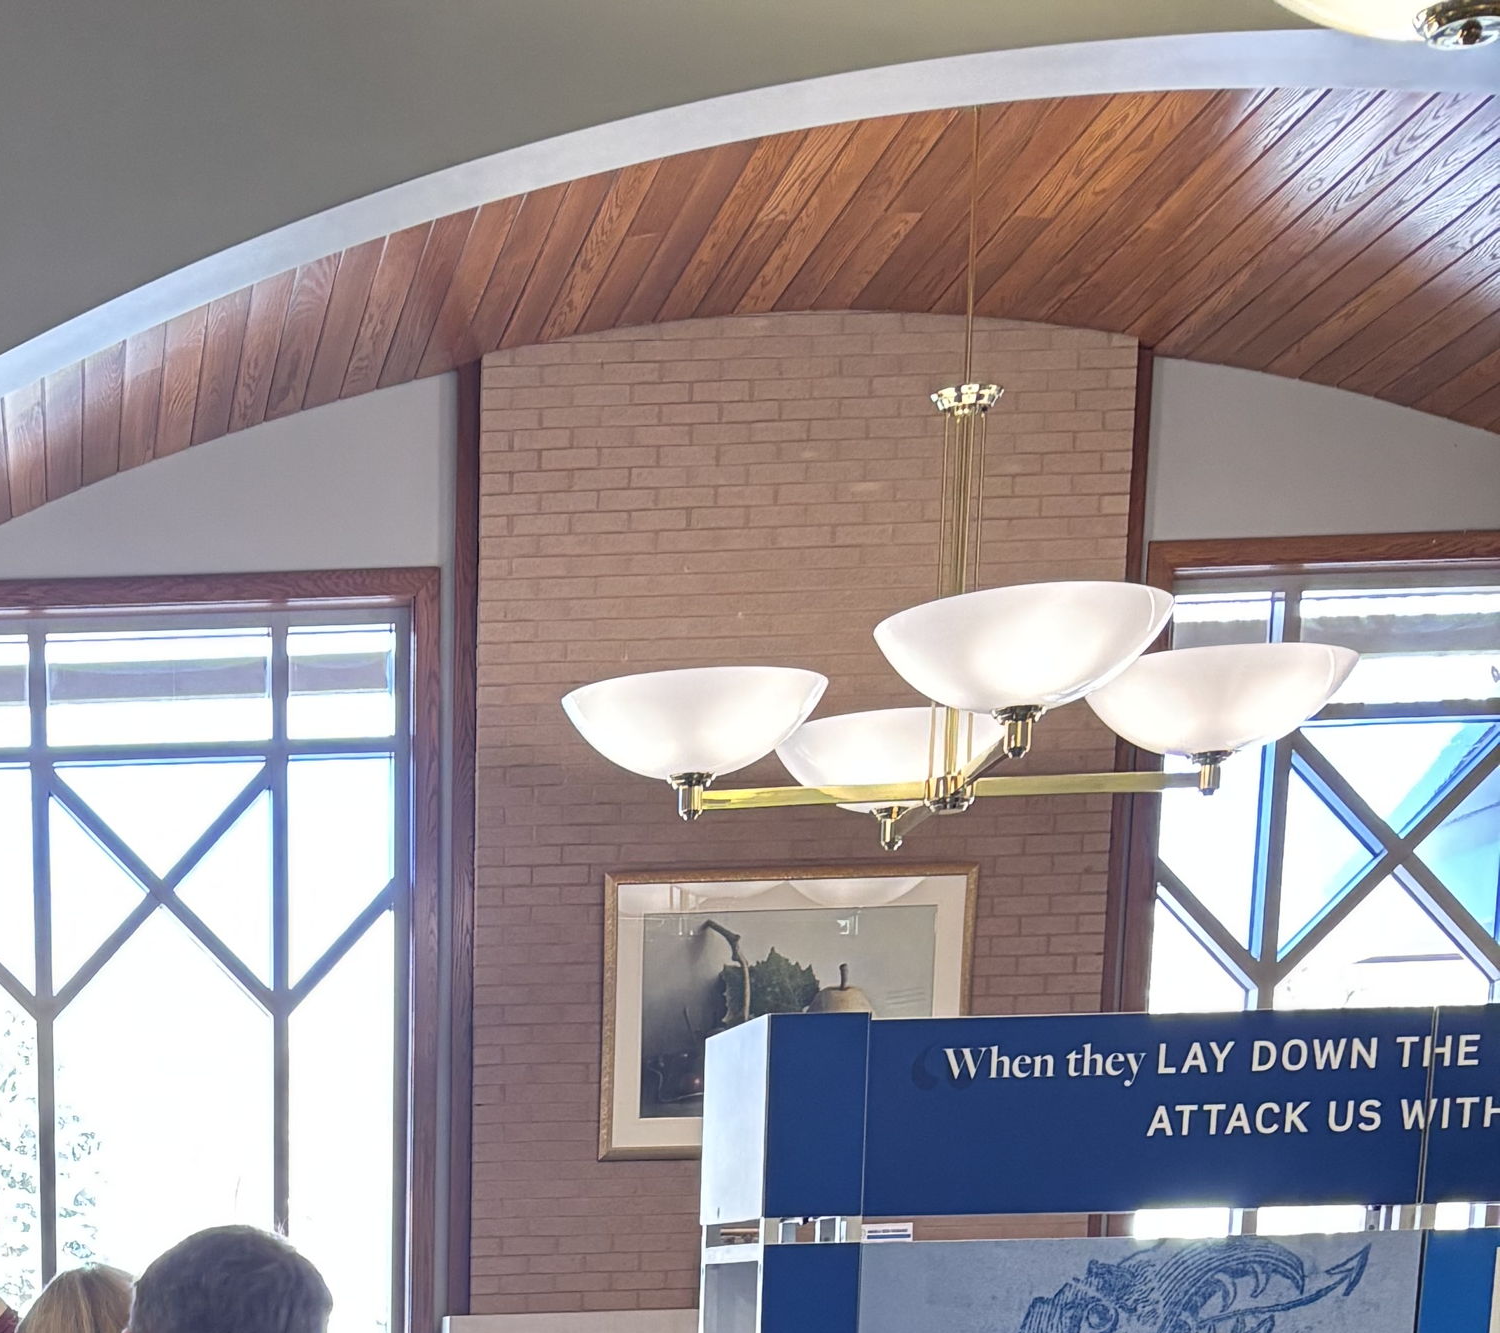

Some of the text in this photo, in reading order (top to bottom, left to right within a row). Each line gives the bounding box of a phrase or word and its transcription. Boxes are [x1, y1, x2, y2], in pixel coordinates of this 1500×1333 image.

[943, 1034, 1481, 1087] When they LAY DOWN THE
[1146, 1102, 1309, 1138] ATTACK
[1326, 1099, 1382, 1134] US
